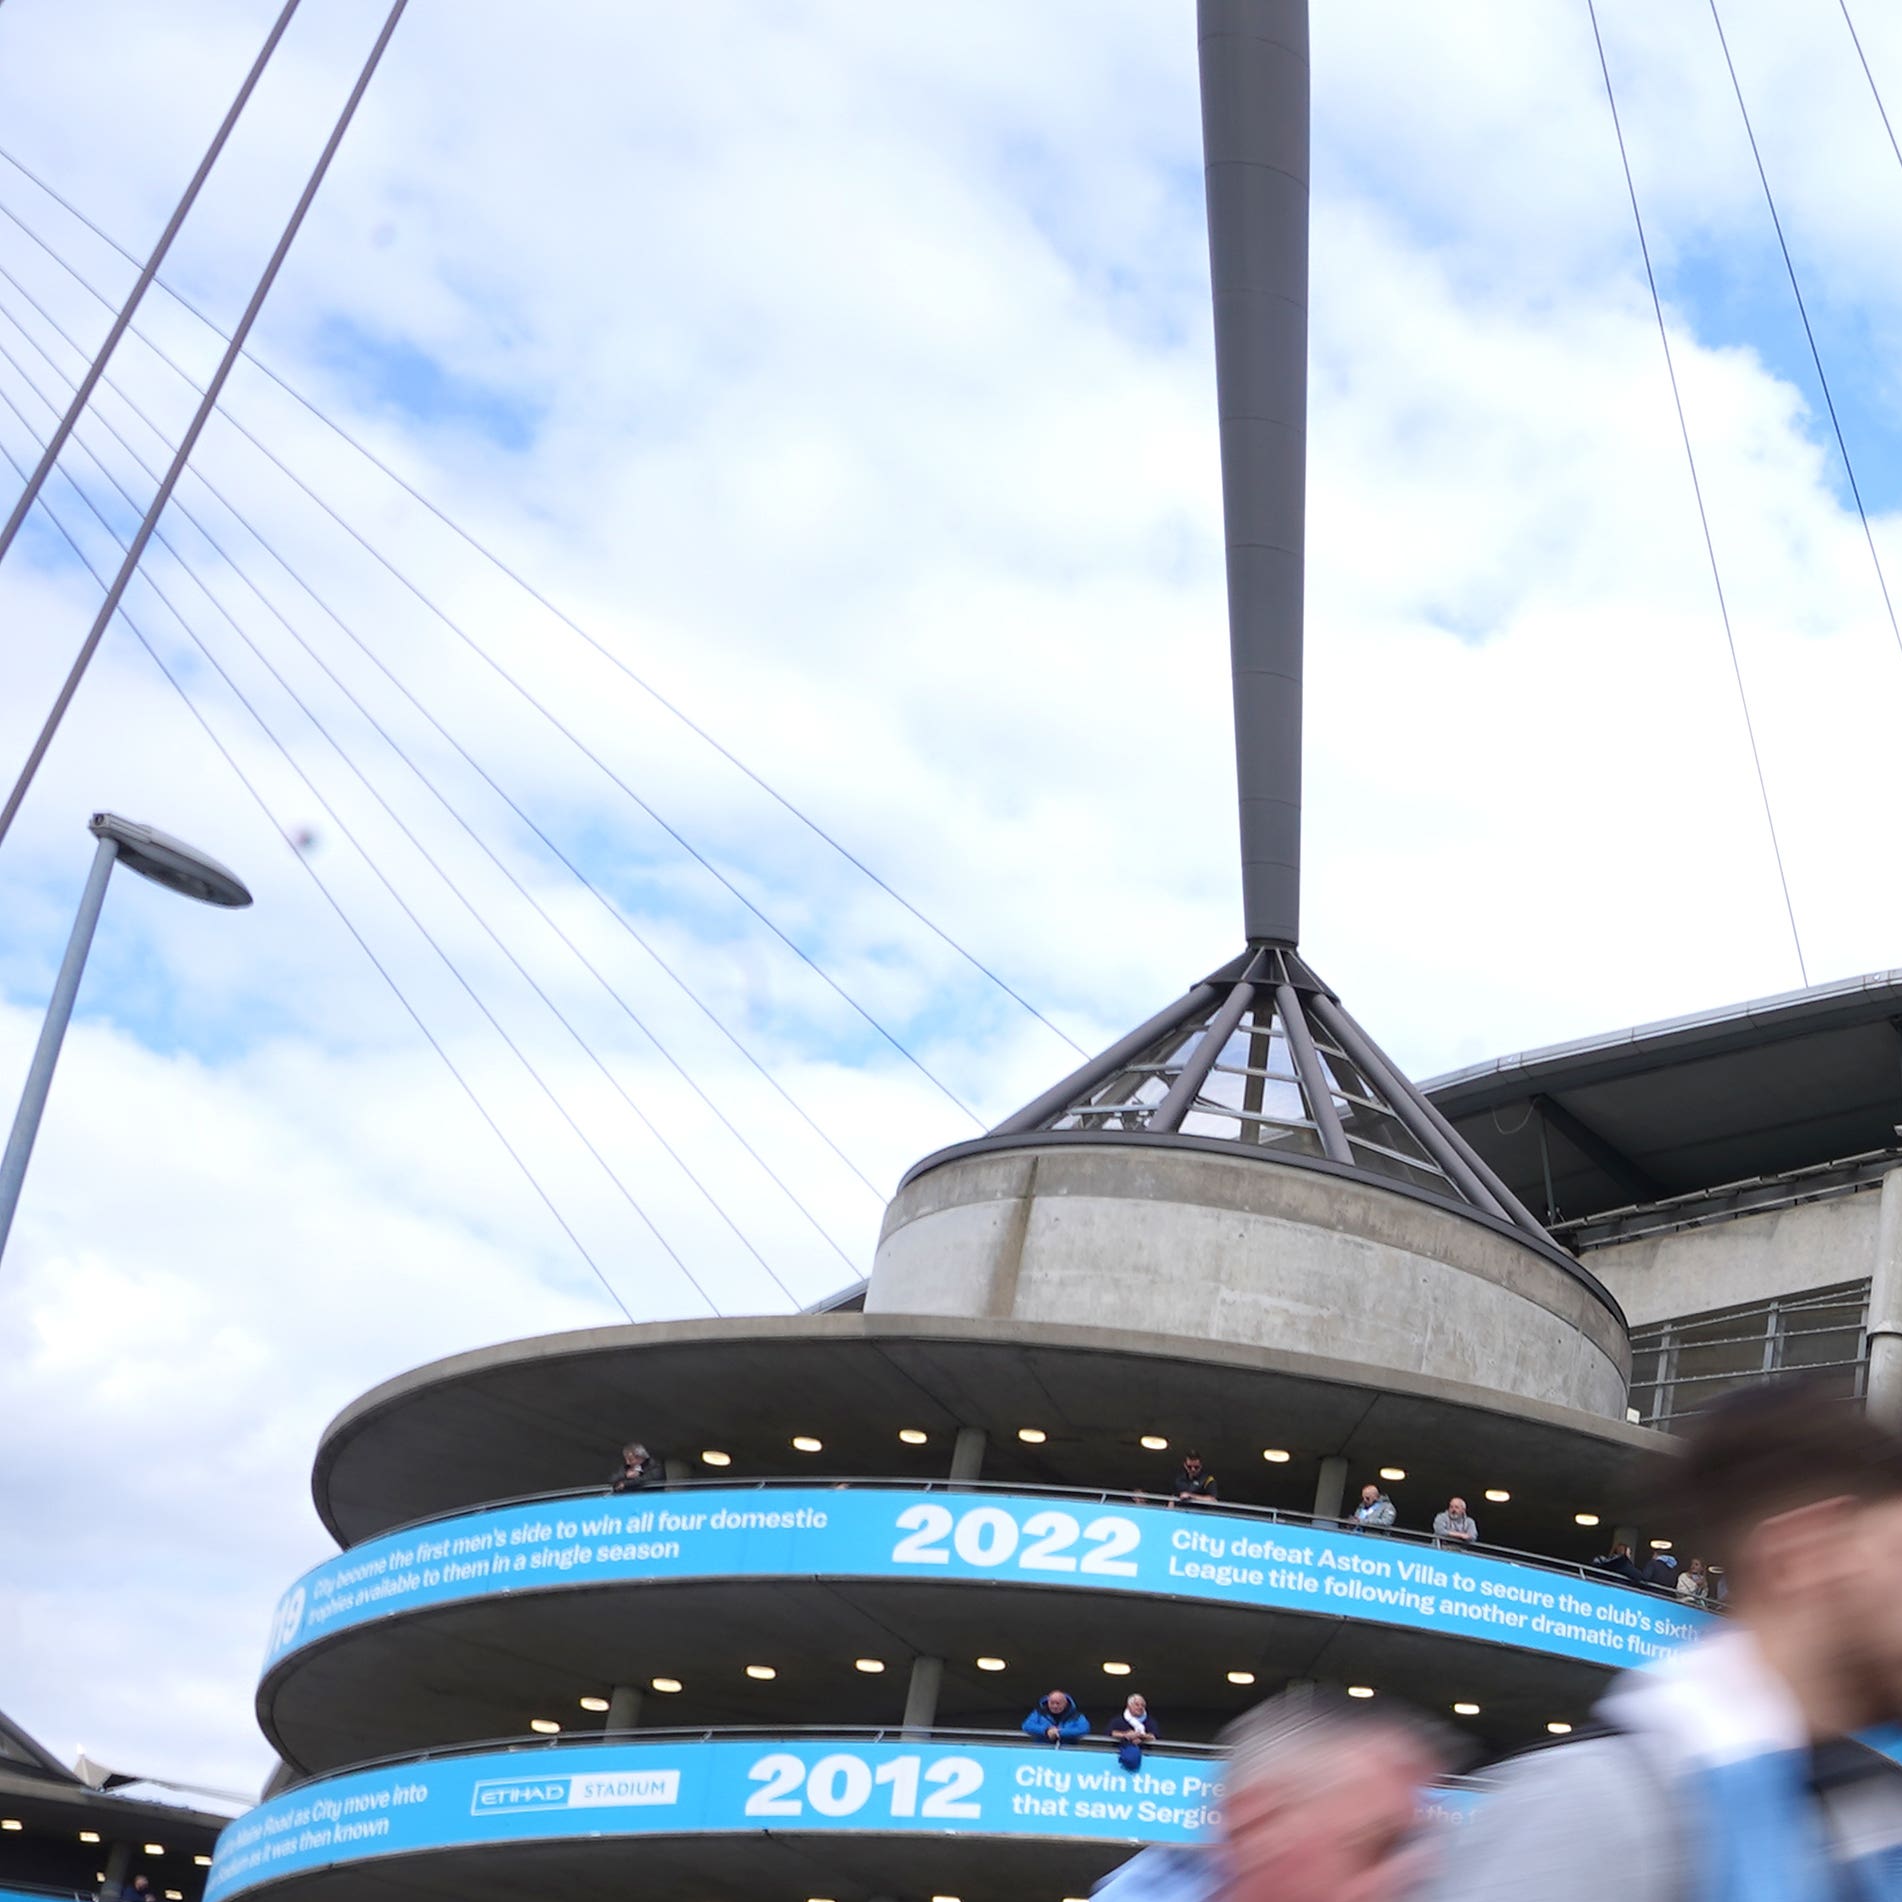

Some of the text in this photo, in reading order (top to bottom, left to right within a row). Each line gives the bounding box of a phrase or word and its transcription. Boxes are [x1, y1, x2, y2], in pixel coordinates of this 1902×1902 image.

[389, 1507, 829, 1571] the first men's side to win all four domestic
[891, 1503, 1142, 1578] 2022
[423, 1540, 681, 1589] to them in single season
[1172, 1528, 1226, 1558] City
[1230, 1537, 1315, 1566] defeat
[1316, 1548, 1392, 1578] Aston
[1396, 1559, 1449, 1588] Villa
[1452, 1571, 1477, 1593] to
[1479, 1579, 1557, 1609] secure
[1558, 1592, 1594, 1618] the
[1596, 1602, 1652, 1632] club's
[1169, 1555, 1624, 1650] League title following another dramatic
[393, 1783, 429, 1806] into
[479, 1779, 666, 1806] ETIHAD STADIUM
[744, 1753, 986, 1821] 2012
[1015, 1764, 1071, 1793] City
[1076, 1770, 1127, 1792] win
[1130, 1774, 1177, 1796] the
[333, 1817, 390, 1845] known
[1012, 1793, 1222, 1830] that saw Sergio
